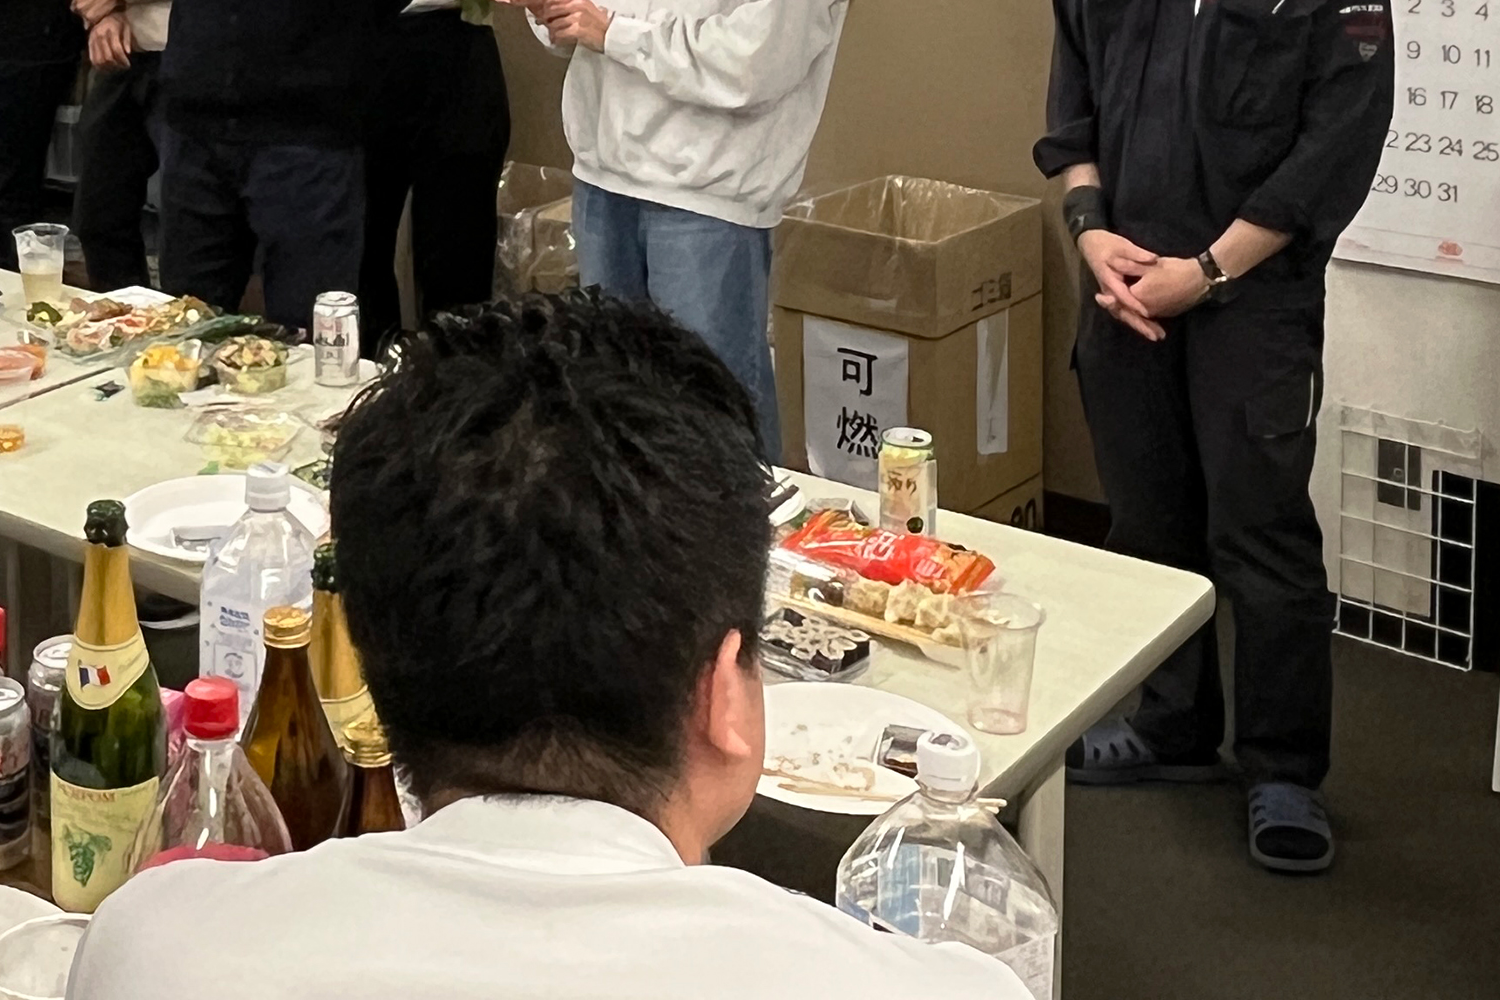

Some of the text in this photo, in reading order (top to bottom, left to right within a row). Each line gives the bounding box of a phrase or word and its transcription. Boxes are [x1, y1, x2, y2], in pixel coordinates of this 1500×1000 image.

[1475, 2, 1488, 21] 4
[1407, 41, 1490, 68] 9 10 11
[1407, 87, 1493, 114] 16 17 18
[1405, 132, 1431, 153] 23
[1438, 136, 1463, 156] 24
[1472, 141, 1499, 162] 25
[1371, 173, 1458, 203] 29 30 31
[836, 347, 879, 460] 可燃
